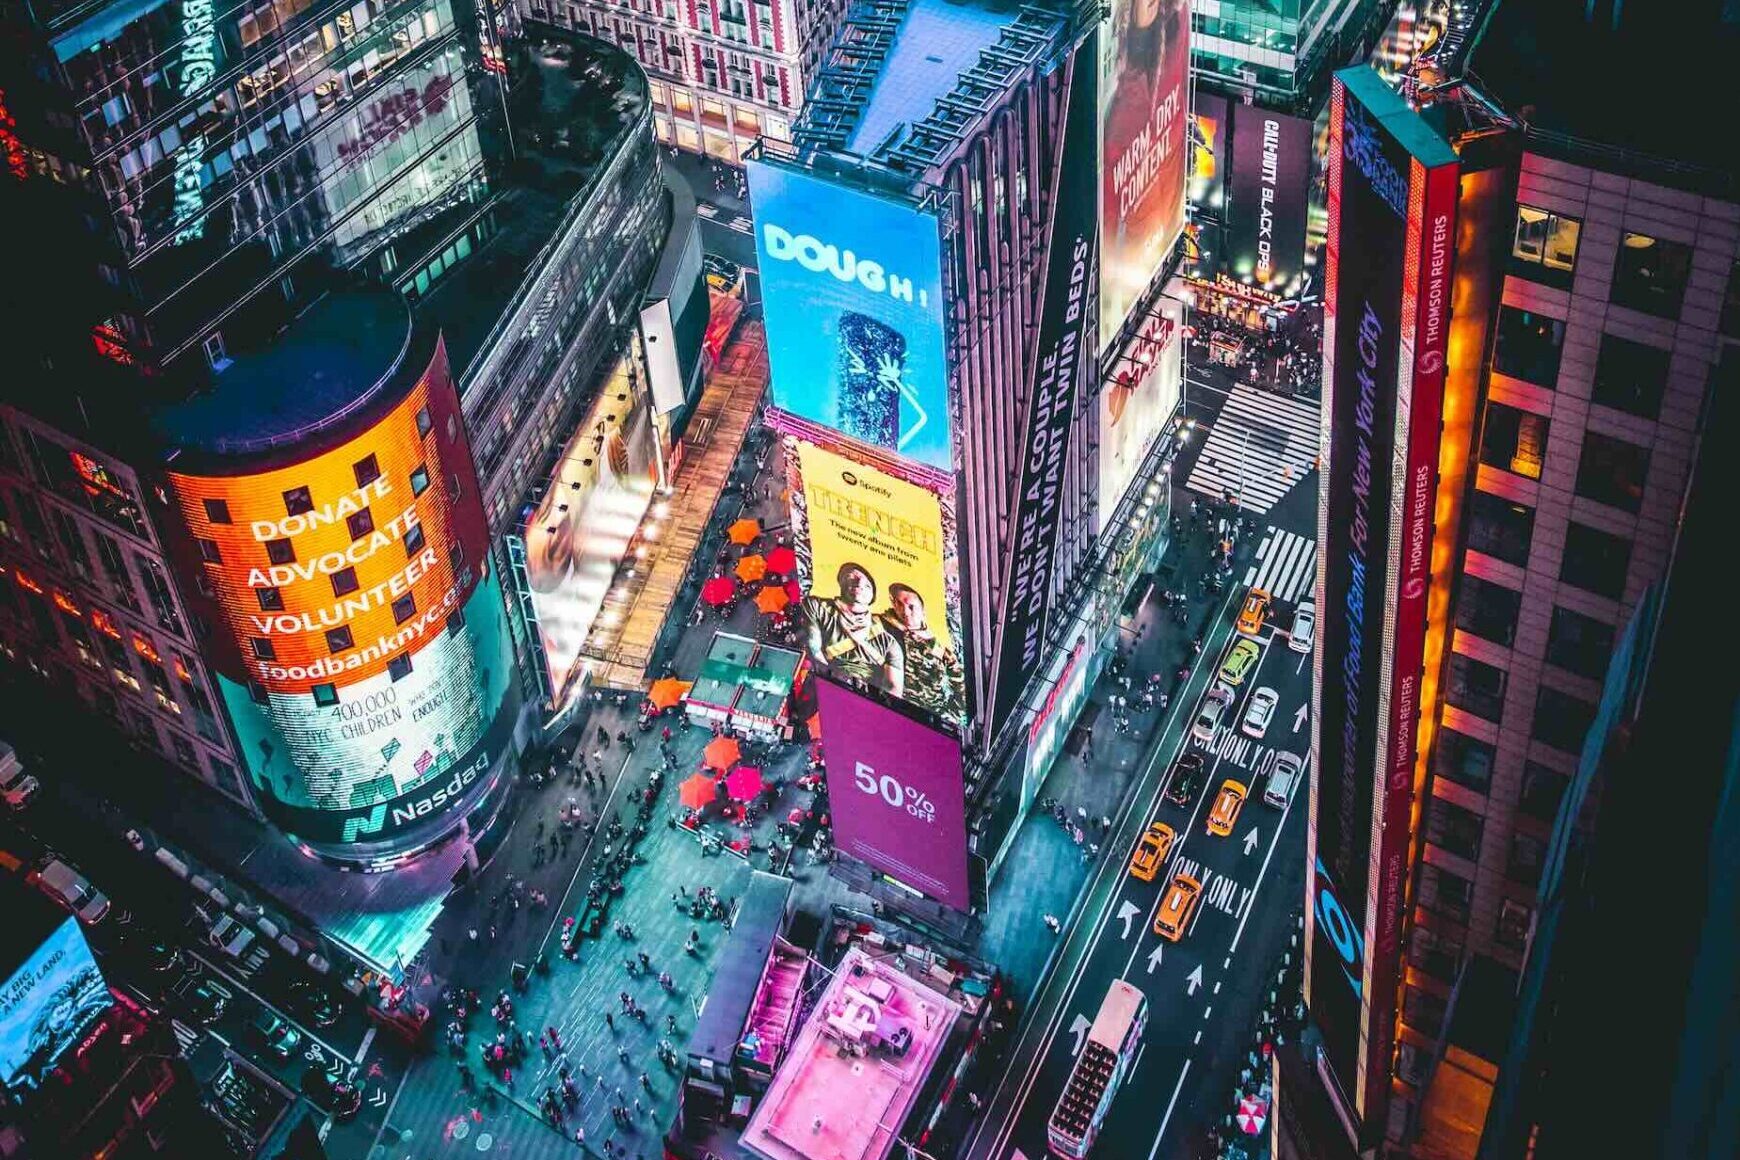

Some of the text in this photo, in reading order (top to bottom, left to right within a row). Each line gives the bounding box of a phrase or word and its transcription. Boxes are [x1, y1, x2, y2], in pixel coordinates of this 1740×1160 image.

[1156, 84, 1181, 137] DRY.
[1257, 187, 1274, 273] BLACK OPS
[1426, 215, 1447, 345] THOMSON REUTERS
[1358, 299, 1384, 368] City
[1053, 331, 1077, 418] TWIN
[1355, 367, 1377, 438] York
[251, 470, 393, 542] DONATE
[859, 479, 893, 498] Spotify
[1026, 477, 1041, 501] A
[1041, 426, 1064, 520] WANT
[1352, 436, 1372, 511] New
[247, 503, 421, 588] ADVOCATE
[829, 519, 920, 561] The new album from
[1410, 465, 1429, 573] THOMSON REUTERS
[251, 547, 439, 635] VOLUNTEER
[869, 546, 887, 556] one
[887, 553, 913, 568] pilots
[1028, 523, 1052, 616] DON'T
[1347, 551, 1367, 625] Bank
[1021, 618, 1040, 671] WE
[331, 687, 397, 723] 400,000
[341, 705, 402, 741] CHILDREN
[1396, 675, 1414, 769] THOMSON REUTERS
[855, 761, 936, 814] 50%
[1223, 735, 1264, 772] ONLY
[392, 751, 489, 826] Nasdaq
[906, 804, 936, 824] OFF
[1208, 874, 1251, 919] ONLY
[4, 1005, 12, 1016] A
[12, 977, 35, 1007] NEW
[11, 970, 31, 992] BIG
